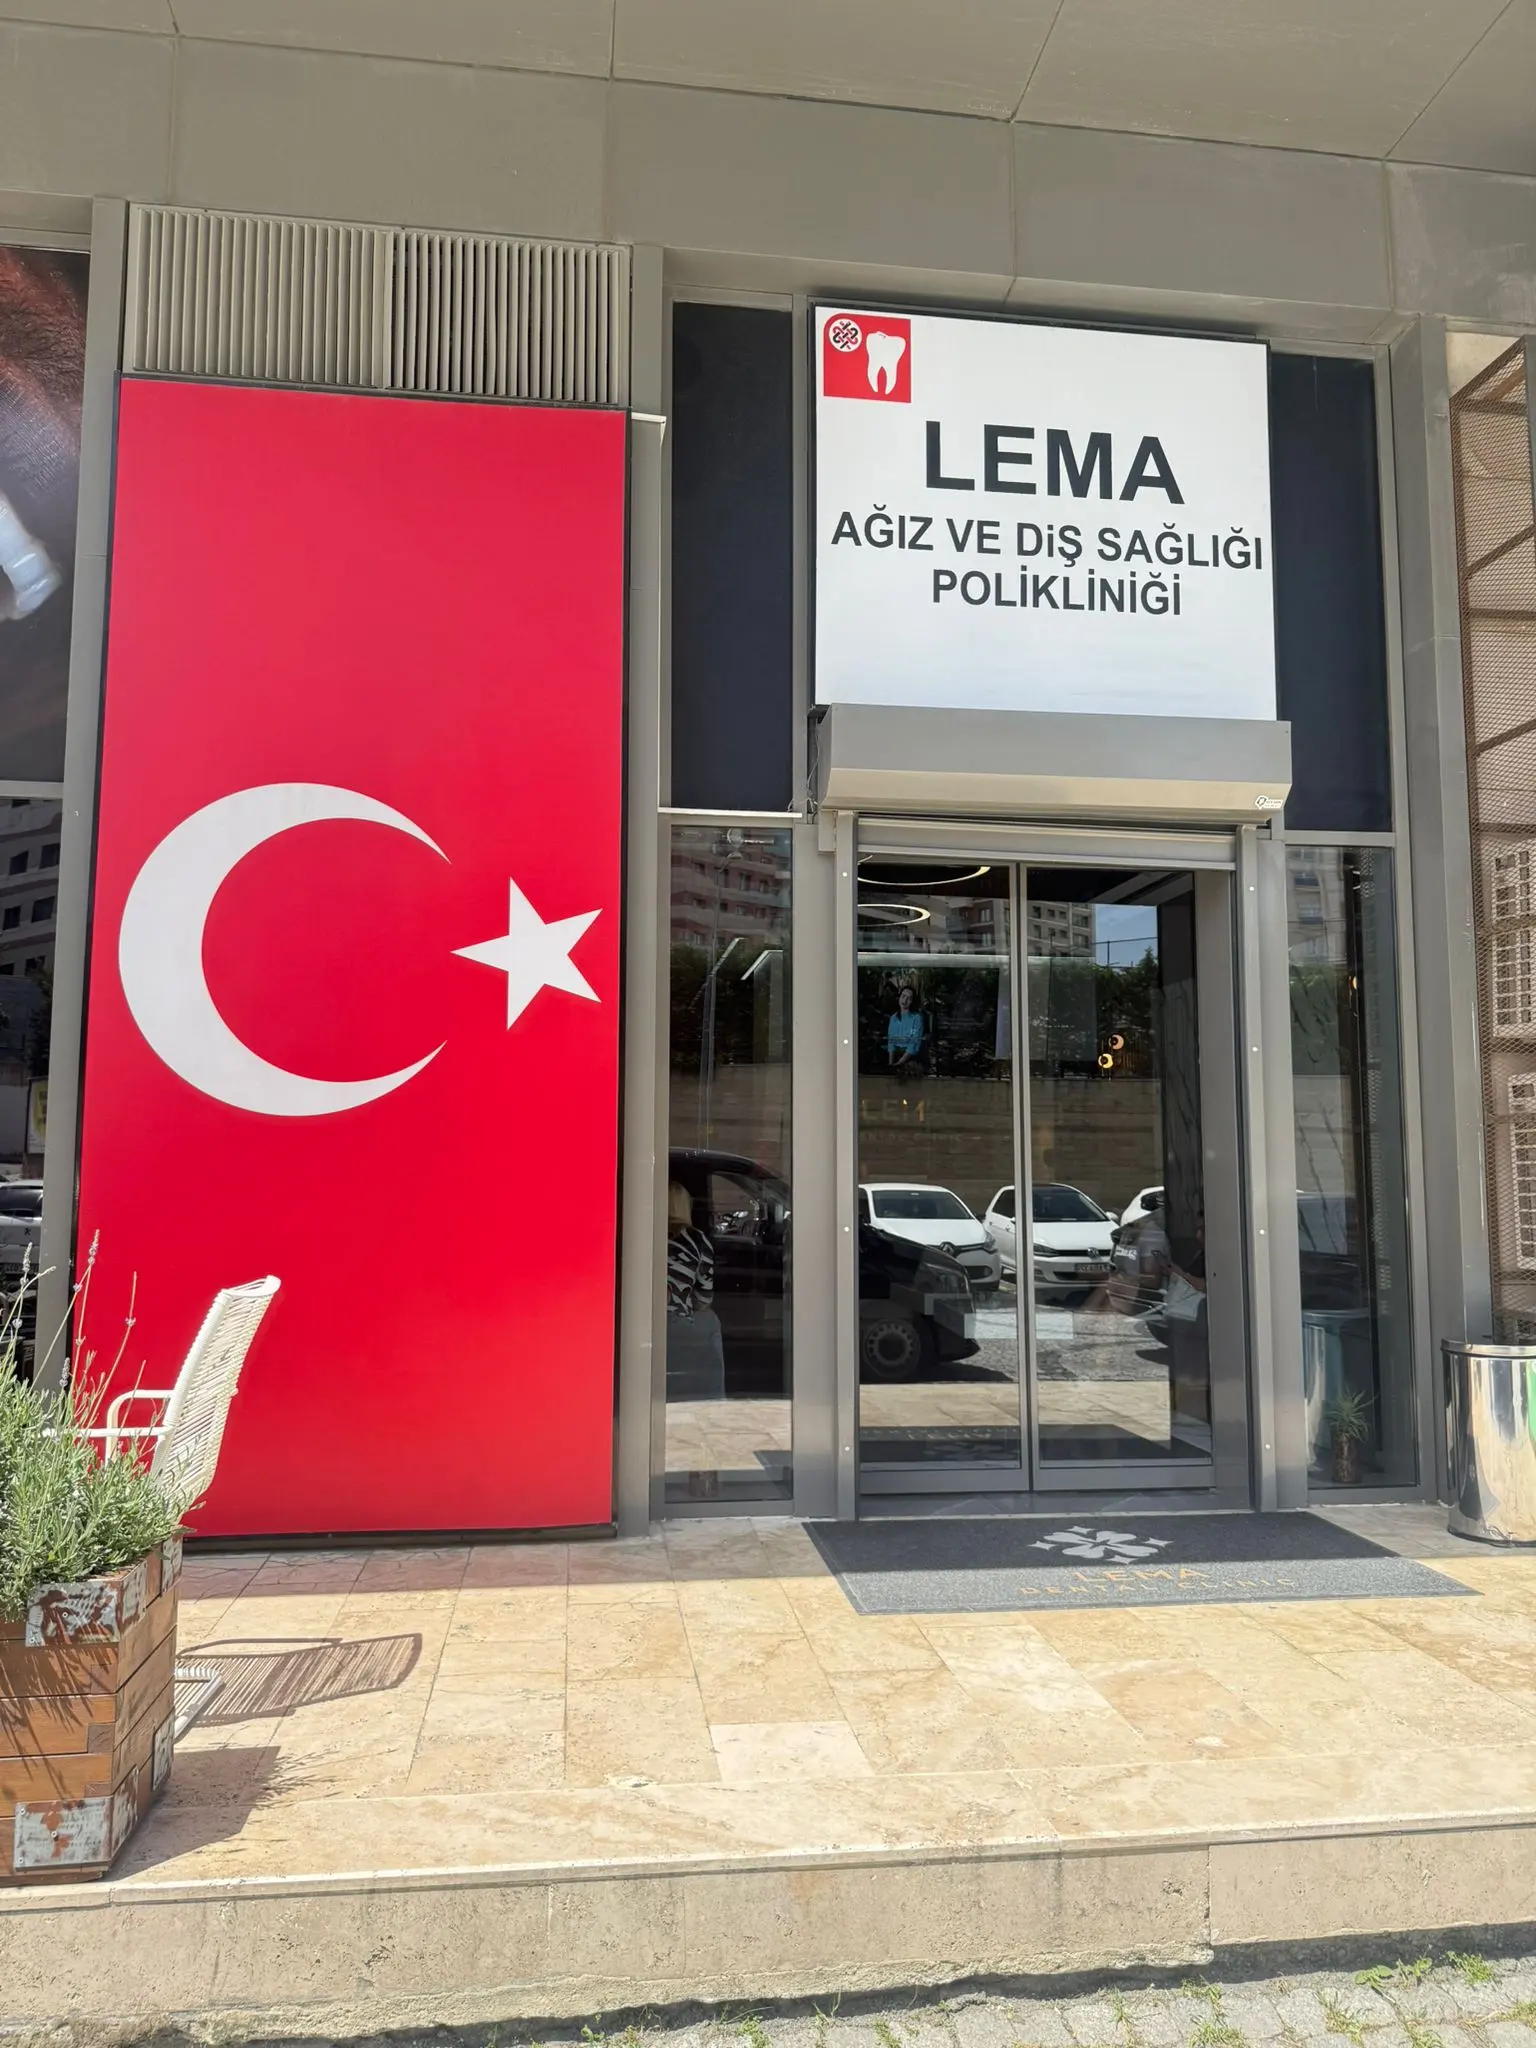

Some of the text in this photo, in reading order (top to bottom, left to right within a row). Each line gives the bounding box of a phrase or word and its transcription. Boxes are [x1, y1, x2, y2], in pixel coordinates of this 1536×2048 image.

[926, 421, 1185, 504] LEMA
[831, 504, 934, 551] AĞIZ
[946, 519, 1001, 554] VE
[1098, 523, 1262, 570] SAĞLIĞI
[934, 565, 1181, 615] POLİKLİNİĞİ
[1019, 1578, 1297, 1595] DENTAL CLINIC
[1070, 1567, 1210, 1582] LEMA
